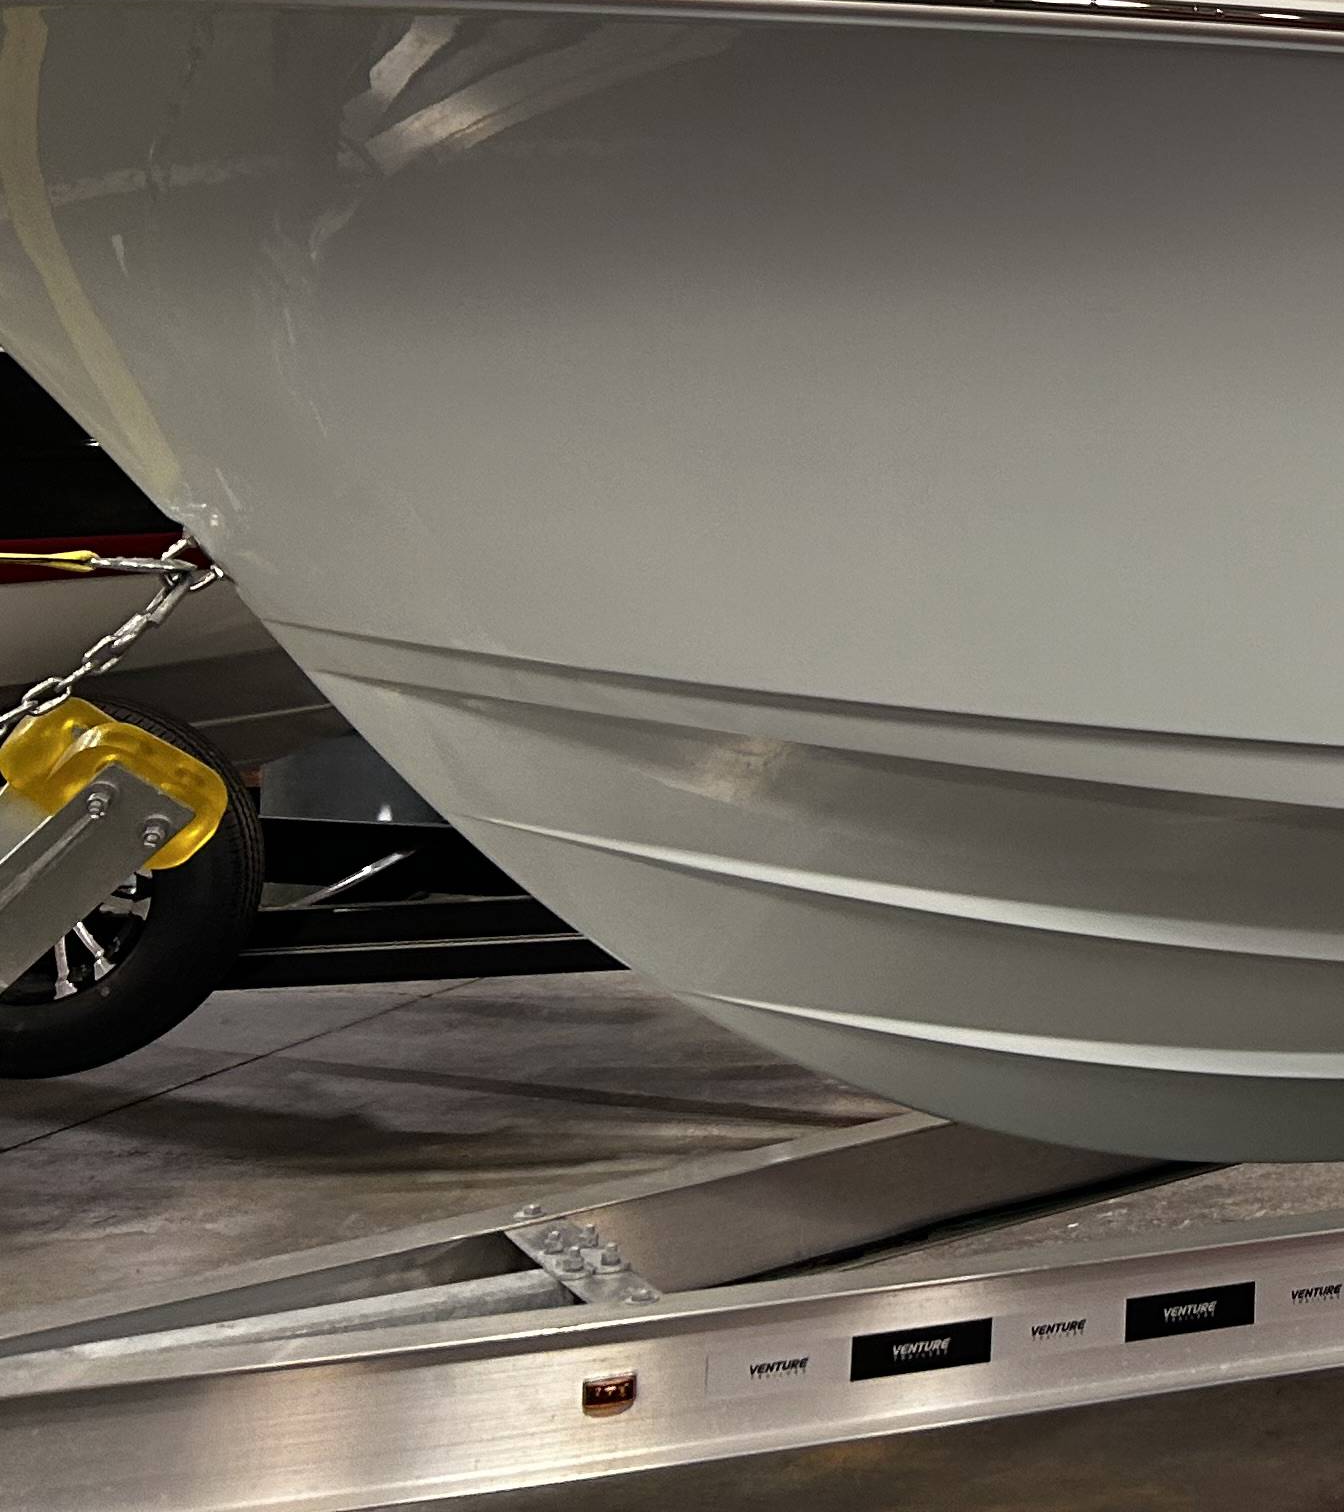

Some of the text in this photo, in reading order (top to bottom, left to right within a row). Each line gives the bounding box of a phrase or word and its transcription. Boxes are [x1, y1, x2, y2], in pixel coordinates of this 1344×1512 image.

[1291, 1284, 1343, 1300] VENTURE
[1163, 1300, 1217, 1318] VENTURE
[1031, 1319, 1087, 1336] VENTURE
[892, 1337, 952, 1356] VENTURE
[750, 1356, 809, 1376] VENTURE
